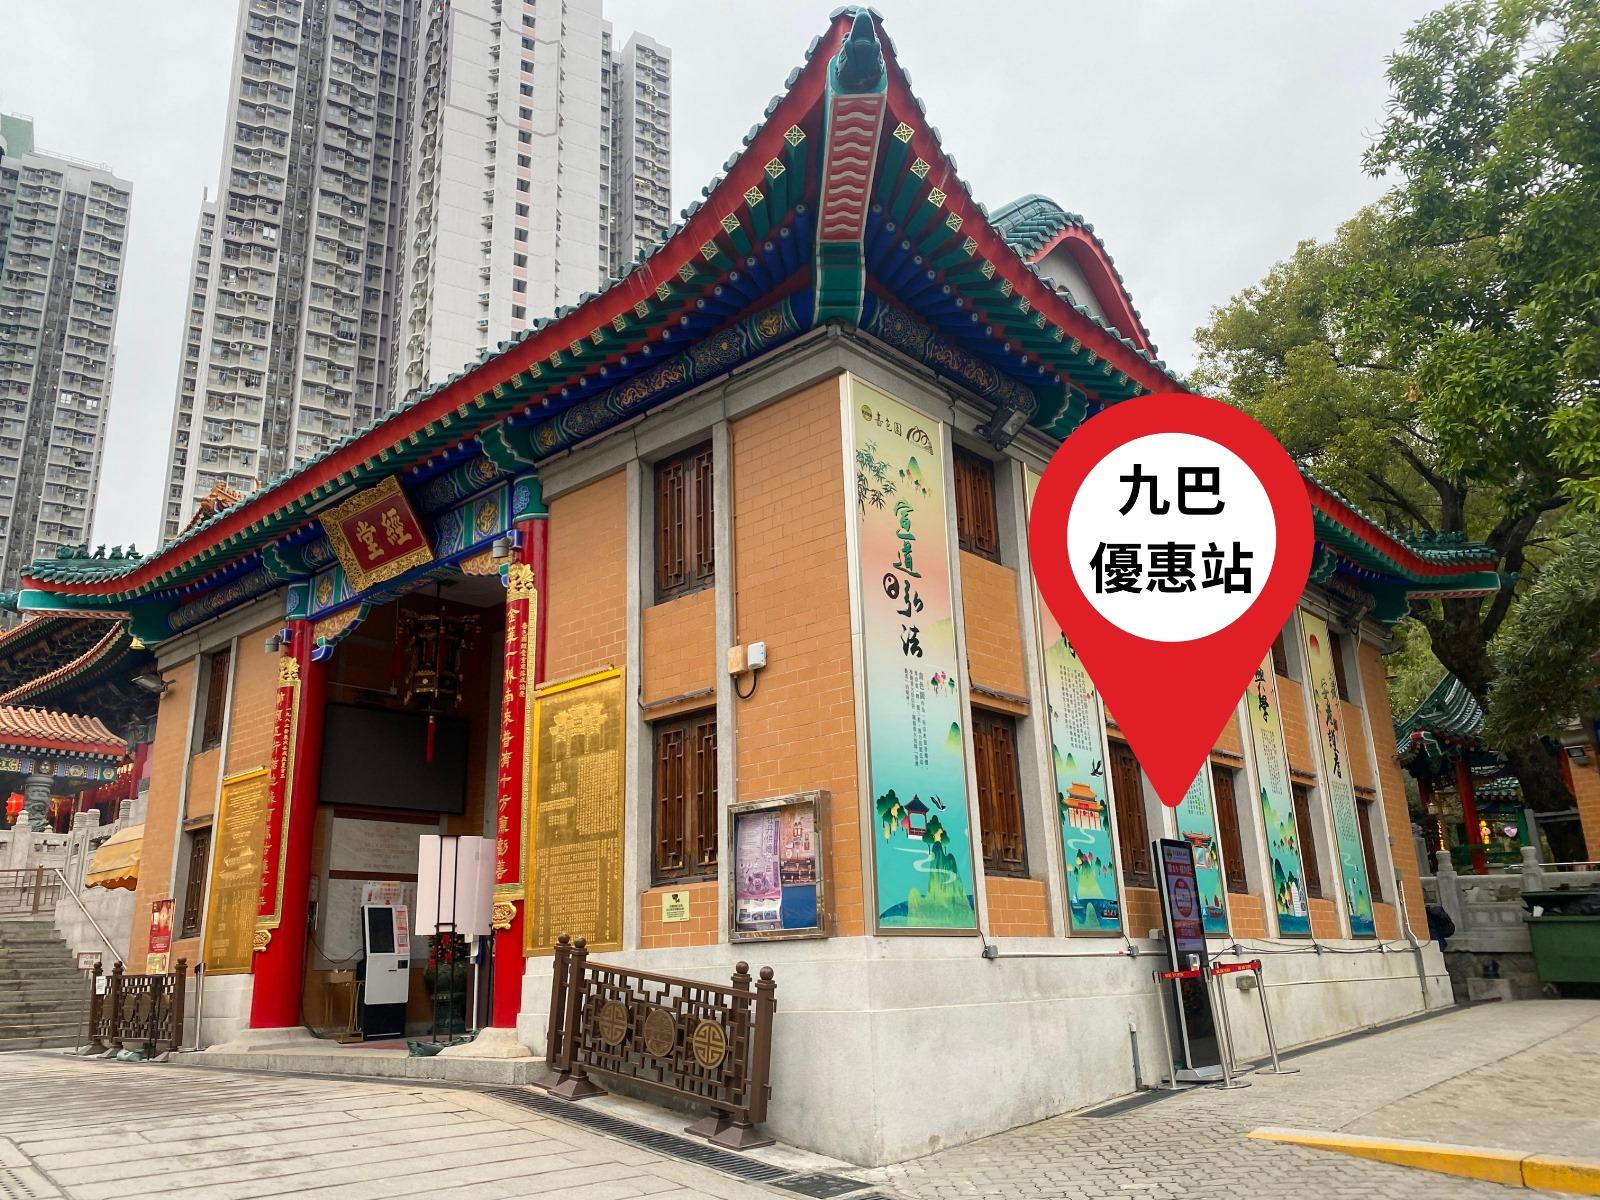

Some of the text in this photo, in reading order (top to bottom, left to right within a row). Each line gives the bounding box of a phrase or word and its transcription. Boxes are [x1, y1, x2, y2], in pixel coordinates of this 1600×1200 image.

[355, 507, 413, 561] 經堂
[893, 499, 924, 658] 宣道弘法
